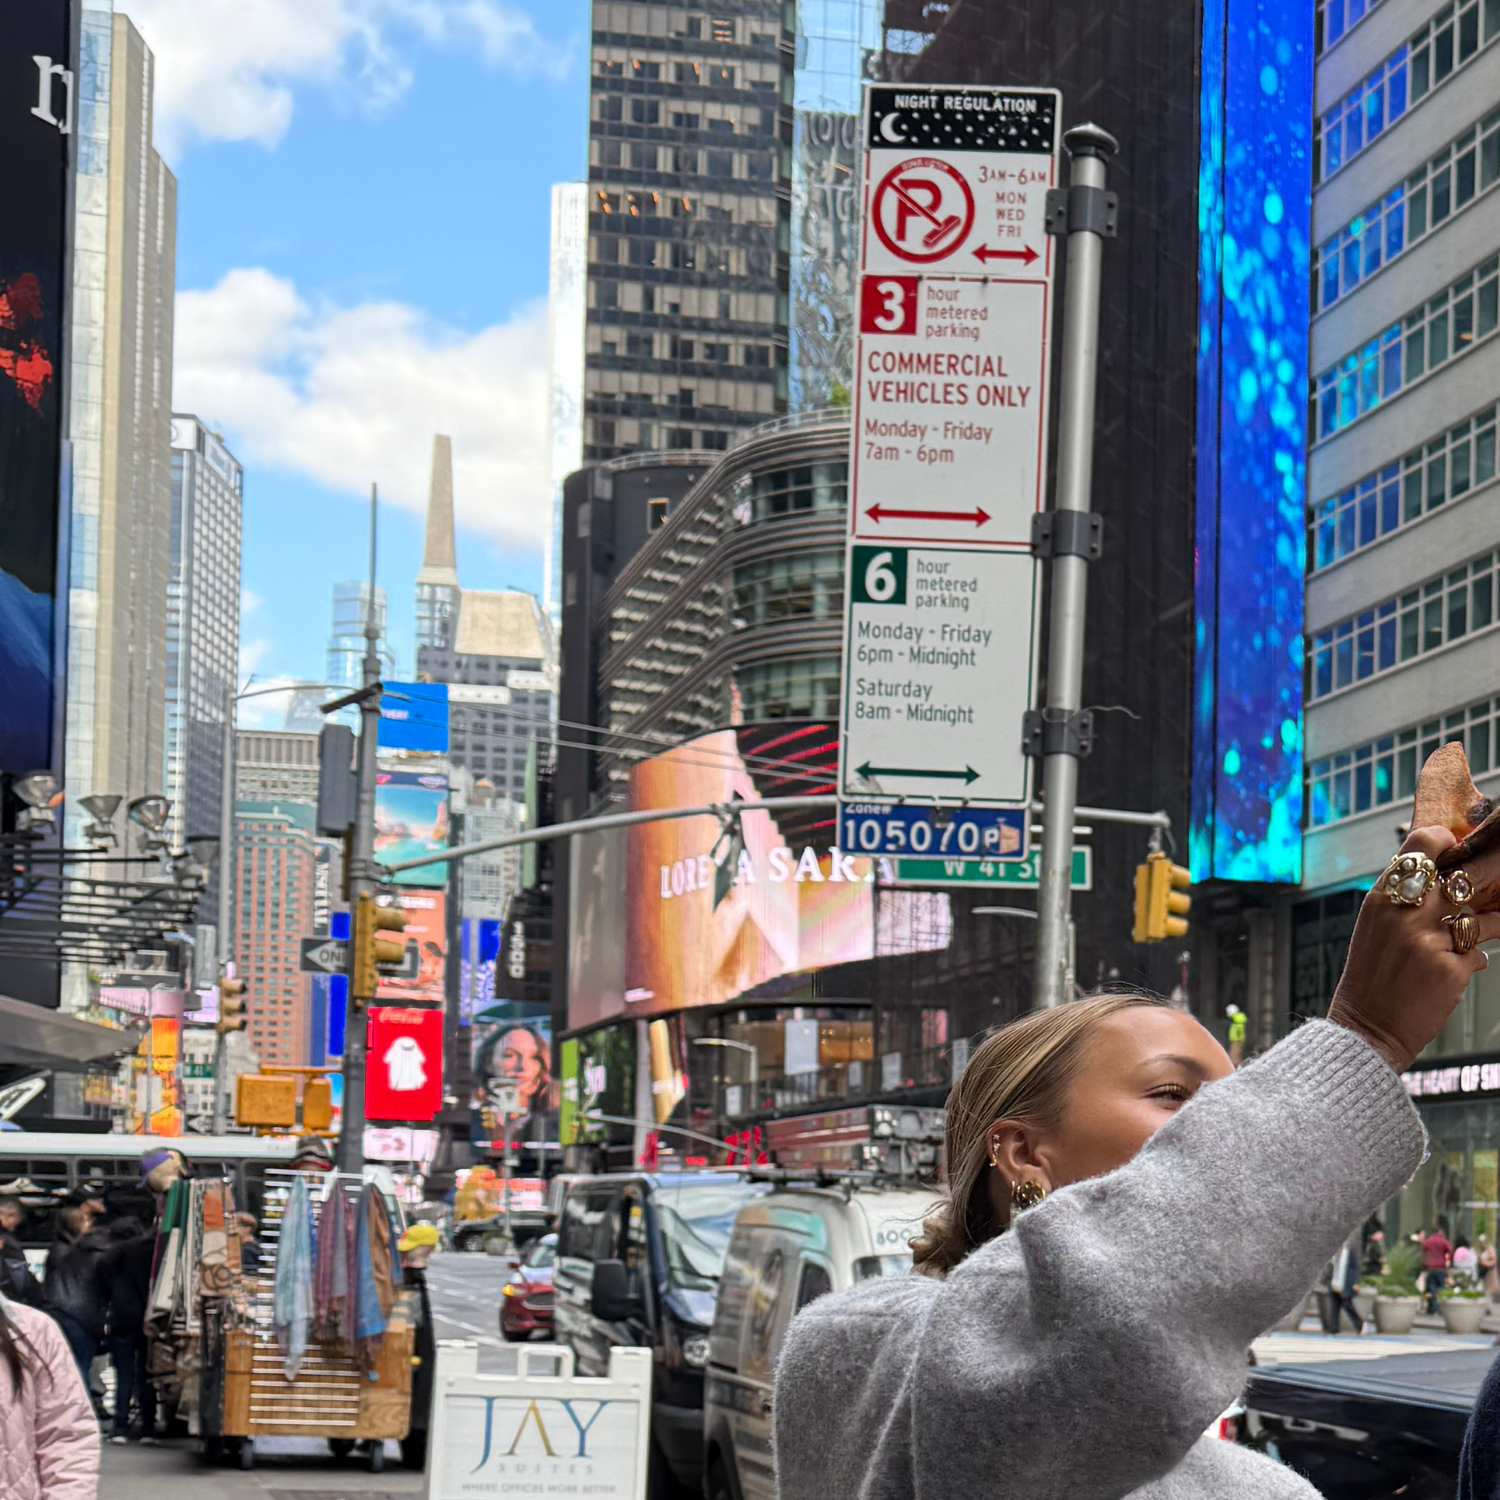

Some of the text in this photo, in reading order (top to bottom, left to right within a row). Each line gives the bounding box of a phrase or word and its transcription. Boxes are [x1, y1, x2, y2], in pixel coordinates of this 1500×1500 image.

[895, 94, 1037, 113] NIGHT REGULATION
[995, 191, 1026, 204] MON
[996, 208, 1025, 221] WED
[997, 225, 1021, 237] FRI
[927, 286, 960, 301] hour
[873, 281, 905, 331] 3
[926, 304, 988, 321] metered
[926, 323, 980, 342] parking
[868, 351, 1008, 378] COMMERCIAL
[868, 381, 1031, 408] VEHICLES ONLY
[865, 419, 927, 442] Monday
[944, 422, 993, 444] Friday
[865, 443, 899, 461] 7am
[917, 444, 954, 464] 6pm
[865, 551, 897, 601] 6
[917, 559, 950, 574] hour
[916, 577, 977, 593] metered
[915, 595, 969, 611] parking
[857, 621, 923, 644] Monday
[941, 625, 992, 645] Friday
[857, 645, 893, 664] 6pm
[909, 647, 976, 668] Midnight
[856, 679, 932, 700] Saturday
[855, 702, 890, 720] 8am
[907, 704, 974, 726] Midnight
[845, 819, 979, 852] 105070
[660, 849, 756, 898] LOREA
[945, 861, 966, 877] W
[979, 861, 1006, 878] 41
[1461, 1064, 1480, 1092] OF
[470, 1396, 613, 1475] JAY
[498, 1462, 594, 1476] SUITES
[461, 1483, 616, 1493] WHERE OFFICES WORK BETTER
